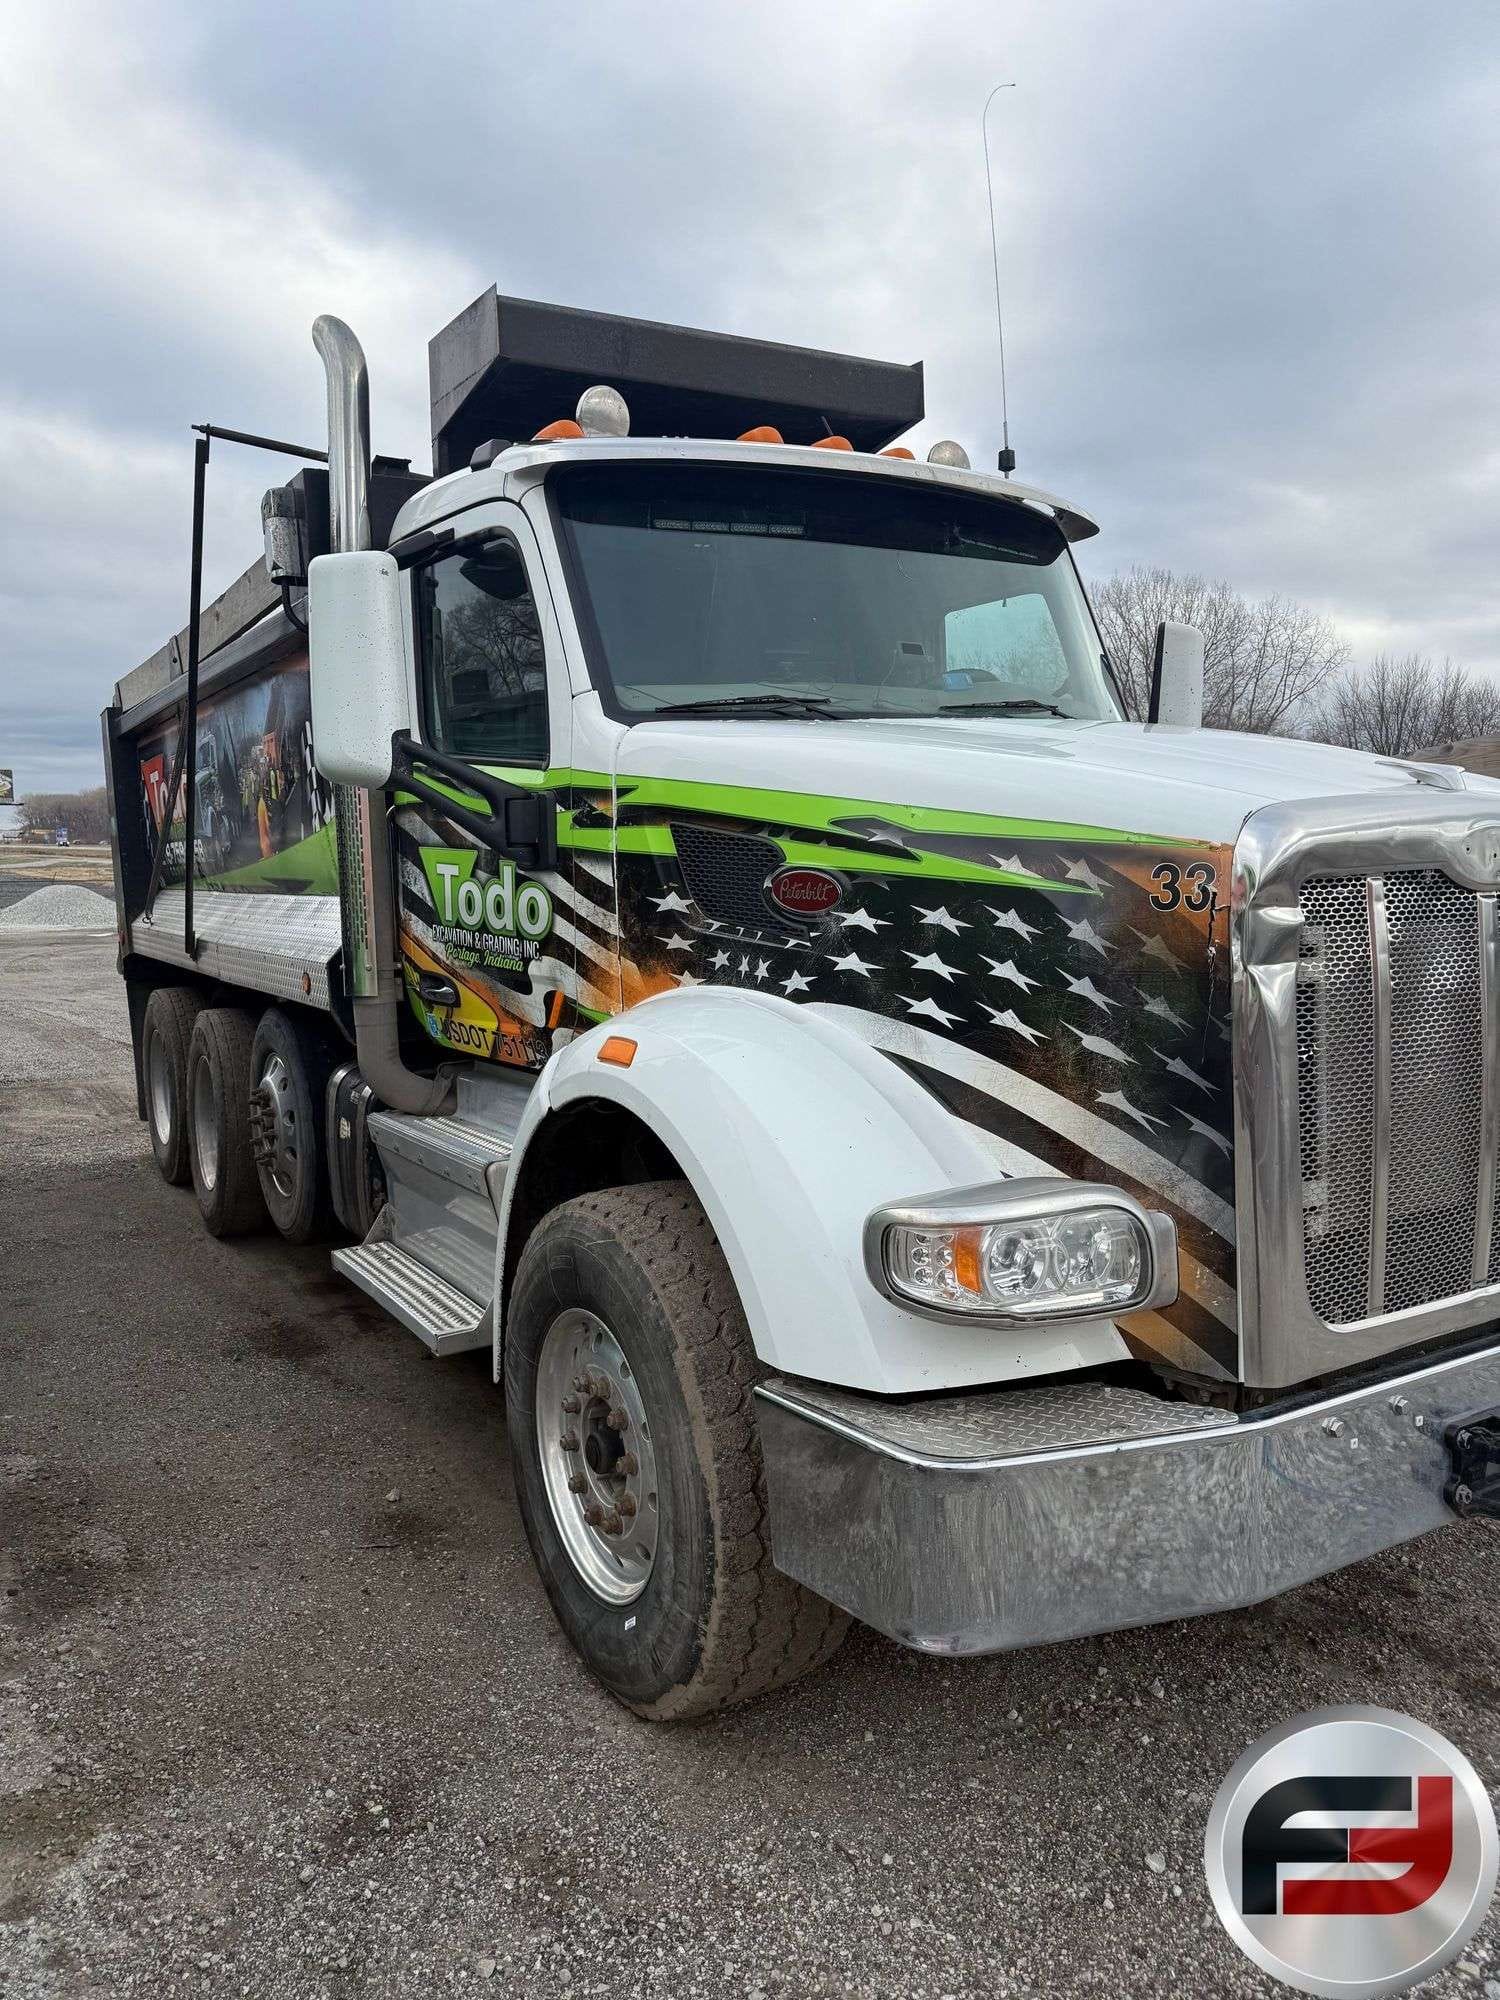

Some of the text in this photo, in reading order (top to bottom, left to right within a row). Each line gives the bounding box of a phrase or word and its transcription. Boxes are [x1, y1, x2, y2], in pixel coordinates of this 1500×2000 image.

[435, 863, 550, 936] Todo
[779, 878, 833, 901] Peterbilt
[1149, 862, 1217, 912] 33
[432, 924, 473, 948] EXCAVATION
[474, 932, 481, 949] &
[523, 940, 543, 961] INC.
[483, 950, 525, 973] Indiana
